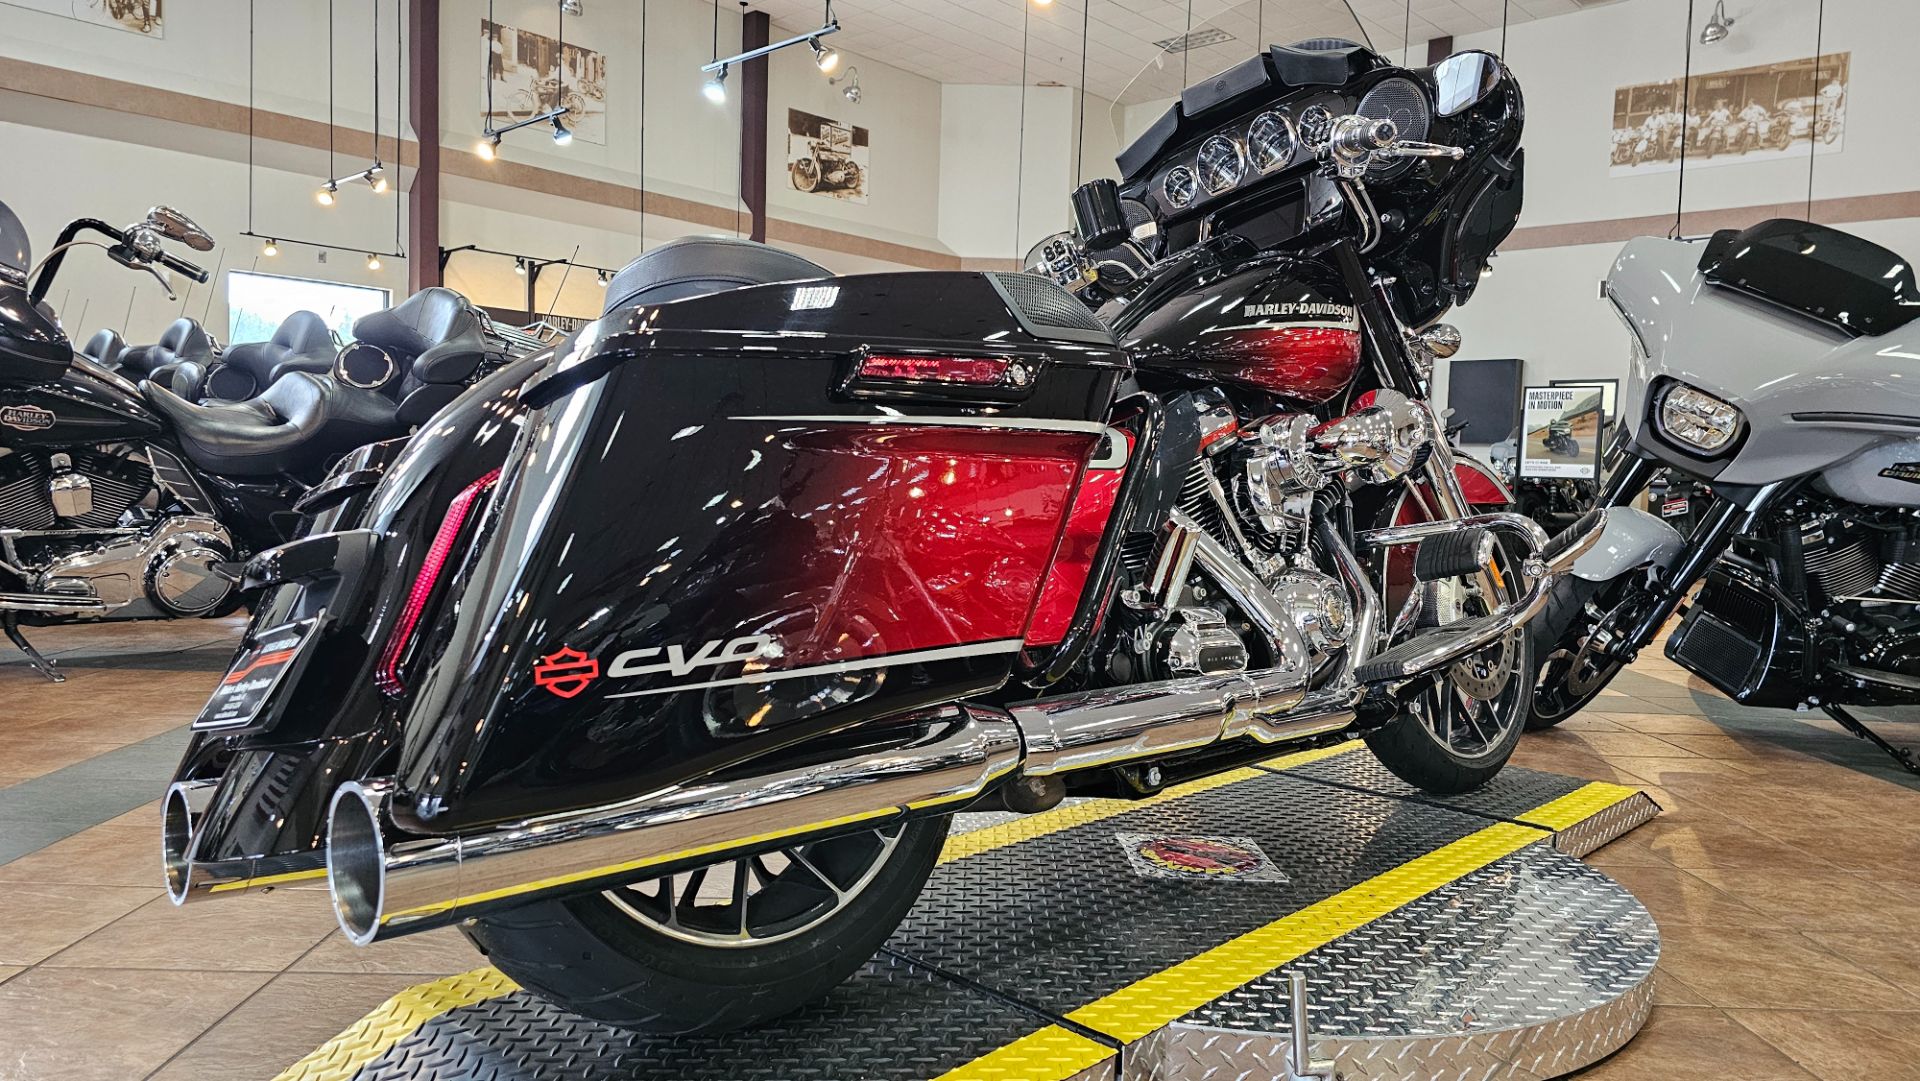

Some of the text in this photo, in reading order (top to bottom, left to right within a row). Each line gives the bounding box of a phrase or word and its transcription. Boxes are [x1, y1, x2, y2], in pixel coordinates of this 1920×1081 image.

[1244, 302, 1353, 317] HARLEY-DAVIDSON
[1529, 391, 1573, 400] MASTERPIECE
[1528, 401, 1563, 409] IN MOTION
[607, 635, 771, 678] CVO
